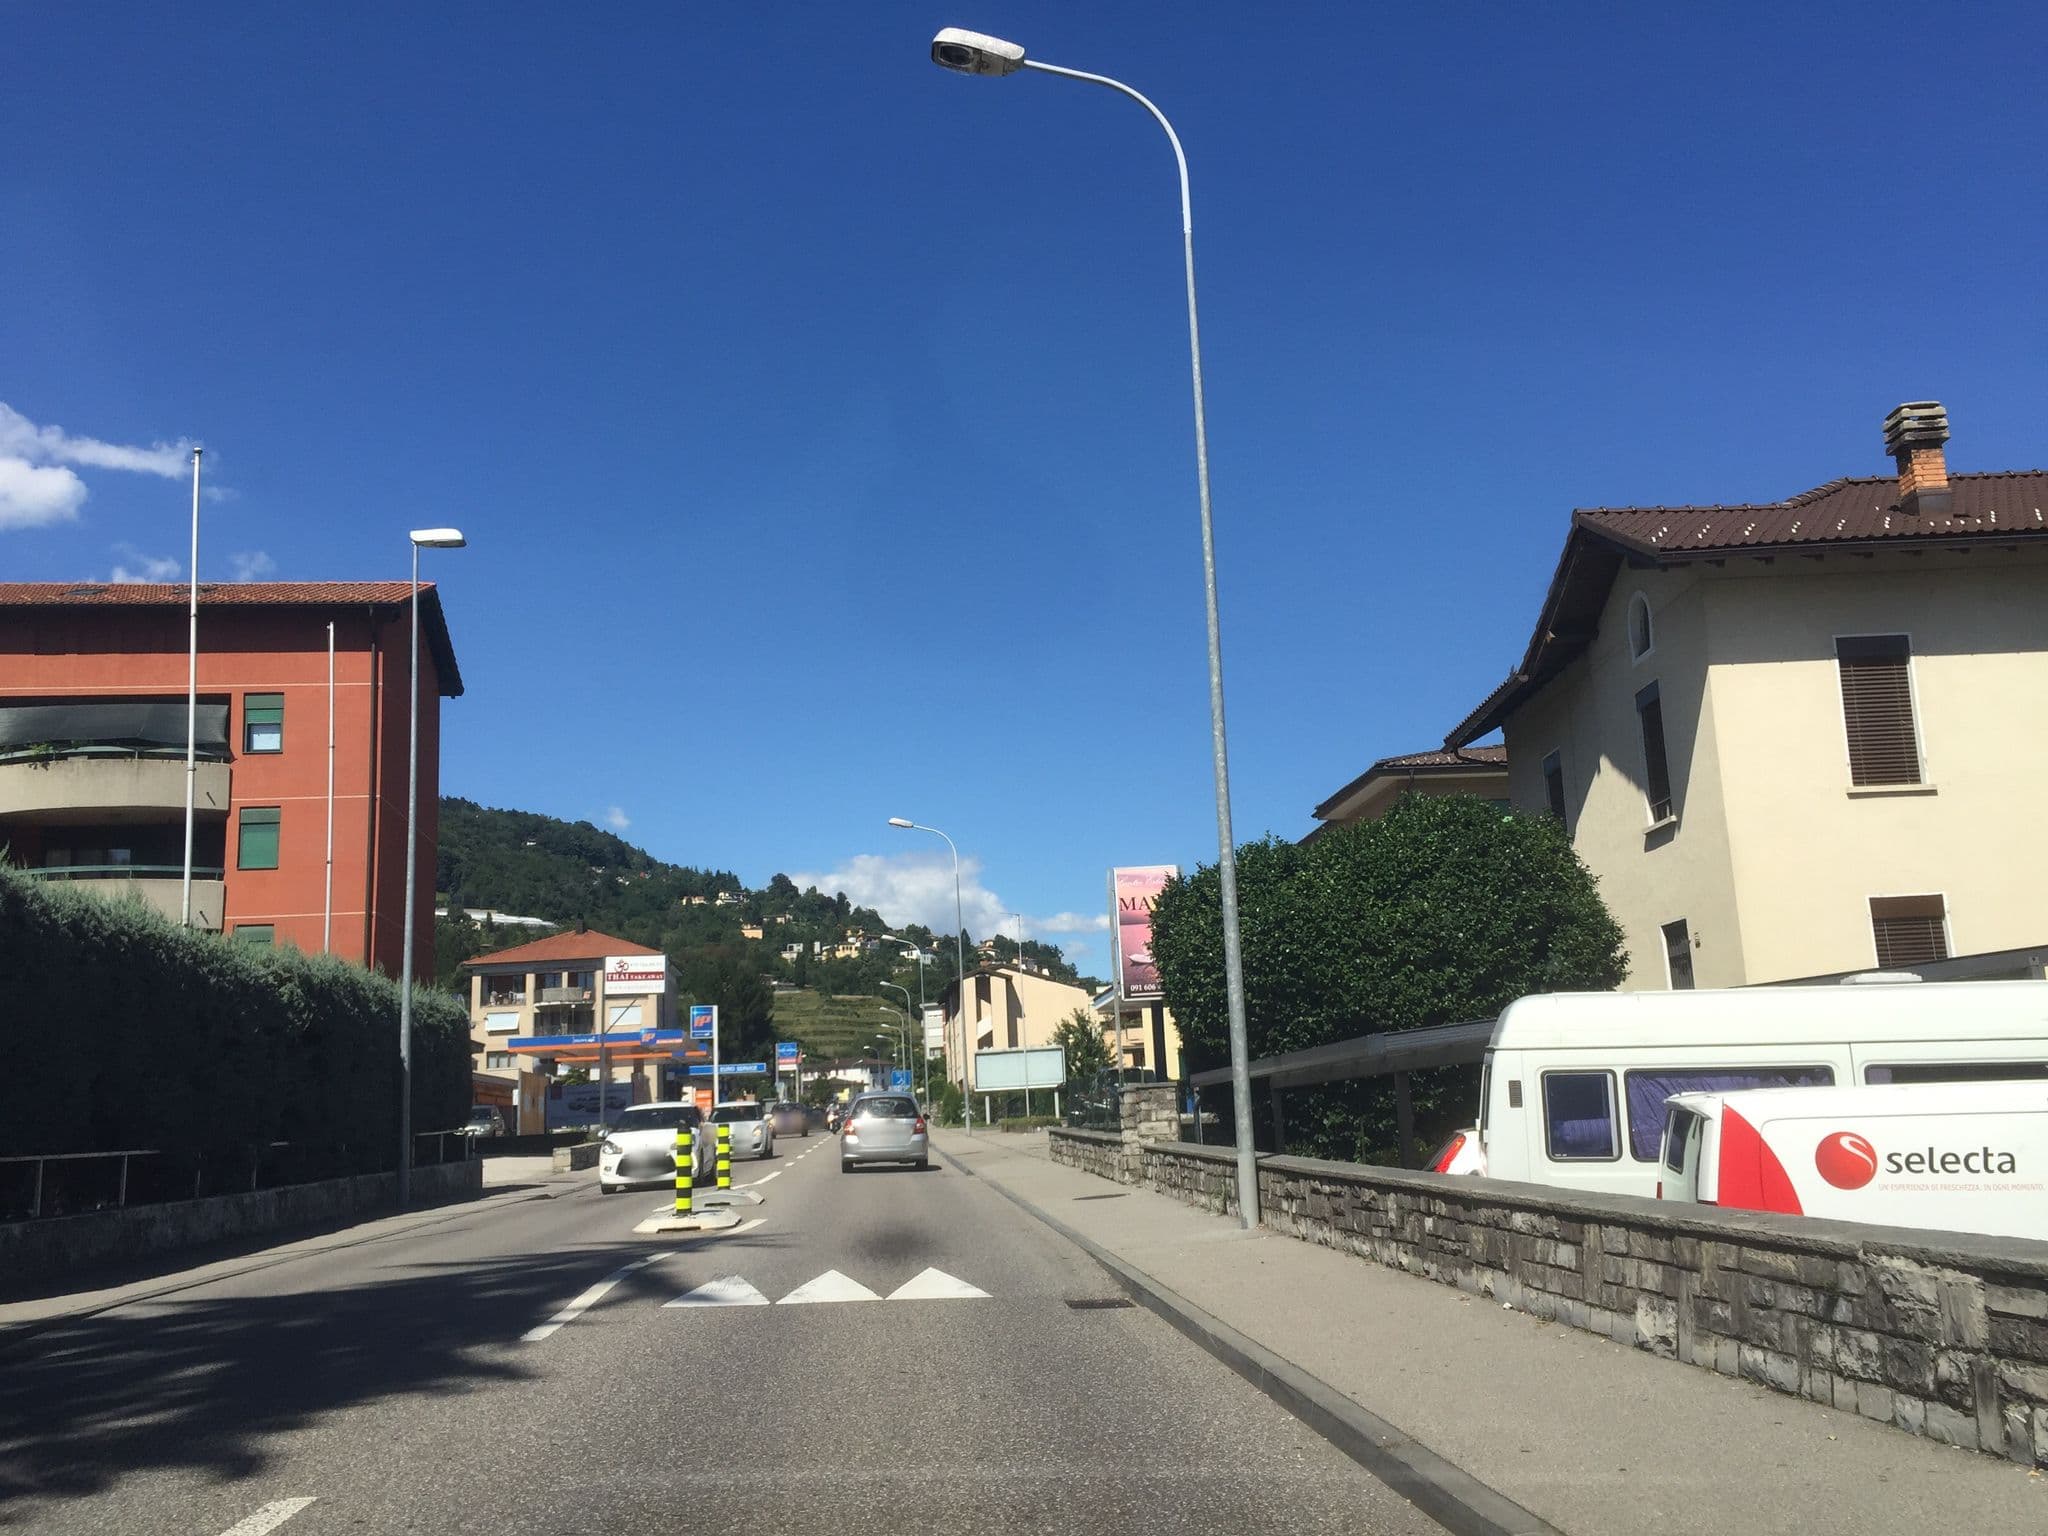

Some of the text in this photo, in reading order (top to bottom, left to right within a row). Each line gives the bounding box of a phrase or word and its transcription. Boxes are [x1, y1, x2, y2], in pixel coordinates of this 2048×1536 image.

[607, 973, 629, 981] THAI
[1130, 984, 1143, 992] 091
[1885, 1146, 2016, 1174] selecta
